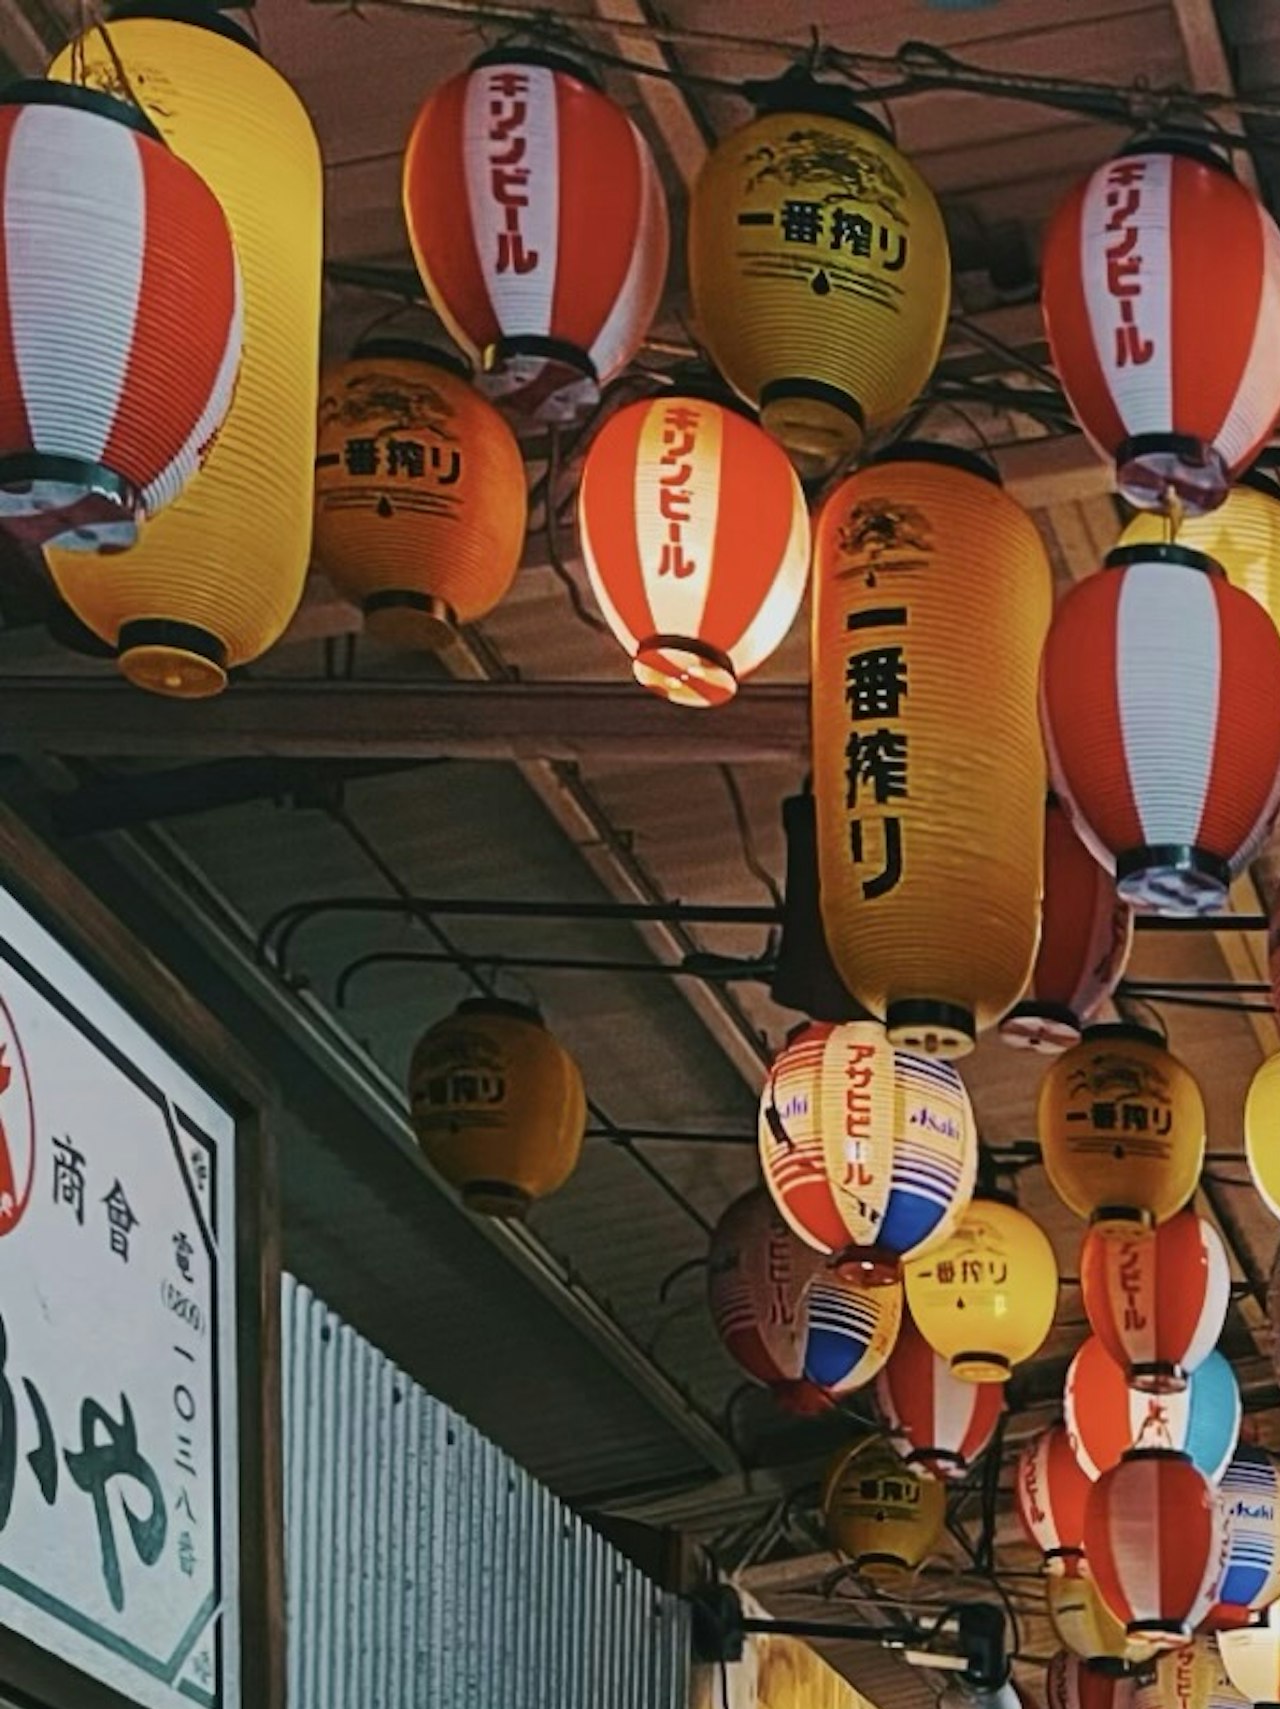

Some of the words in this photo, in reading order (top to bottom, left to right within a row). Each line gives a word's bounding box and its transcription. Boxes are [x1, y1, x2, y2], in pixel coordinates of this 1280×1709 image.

[490, 71, 538, 276] キリンビール
[737, 199, 908, 272] 一番搾り
[1105, 162, 1154, 367] キリンビール
[659, 404, 697, 579] キリンビール
[846, 607, 909, 900] 一番搾り
[842, 1044, 877, 1187] アサヒビール
[910, 1106, 962, 1143] Asahi
[1067, 1101, 1174, 1135] 一番搾り
